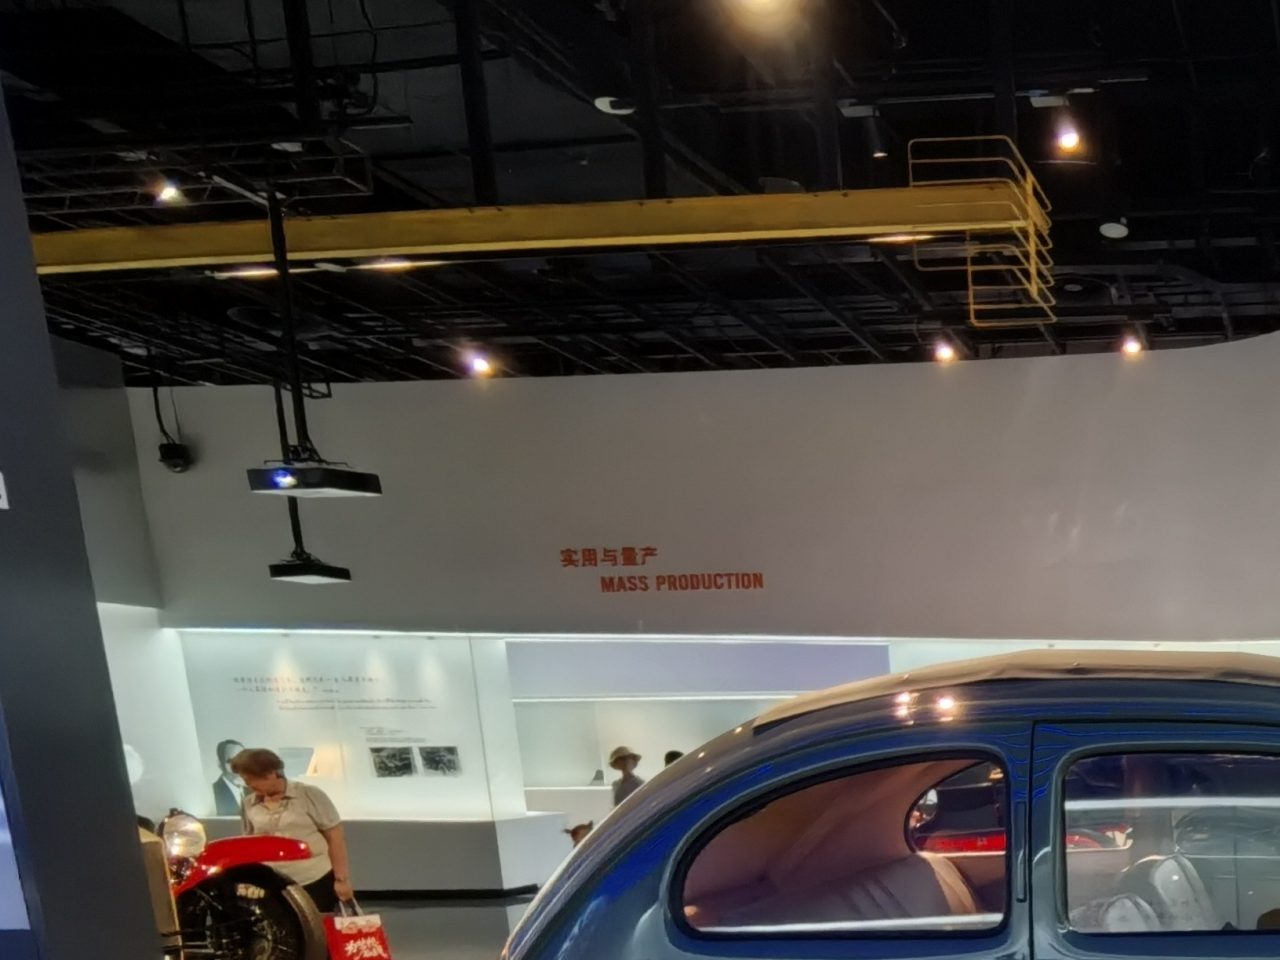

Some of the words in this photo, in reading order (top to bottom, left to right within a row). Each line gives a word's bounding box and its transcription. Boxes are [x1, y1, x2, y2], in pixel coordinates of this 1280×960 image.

[559, 546, 658, 568] 实用与量产
[600, 575, 650, 593] MASS
[656, 572, 764, 592] PRODUCTION
